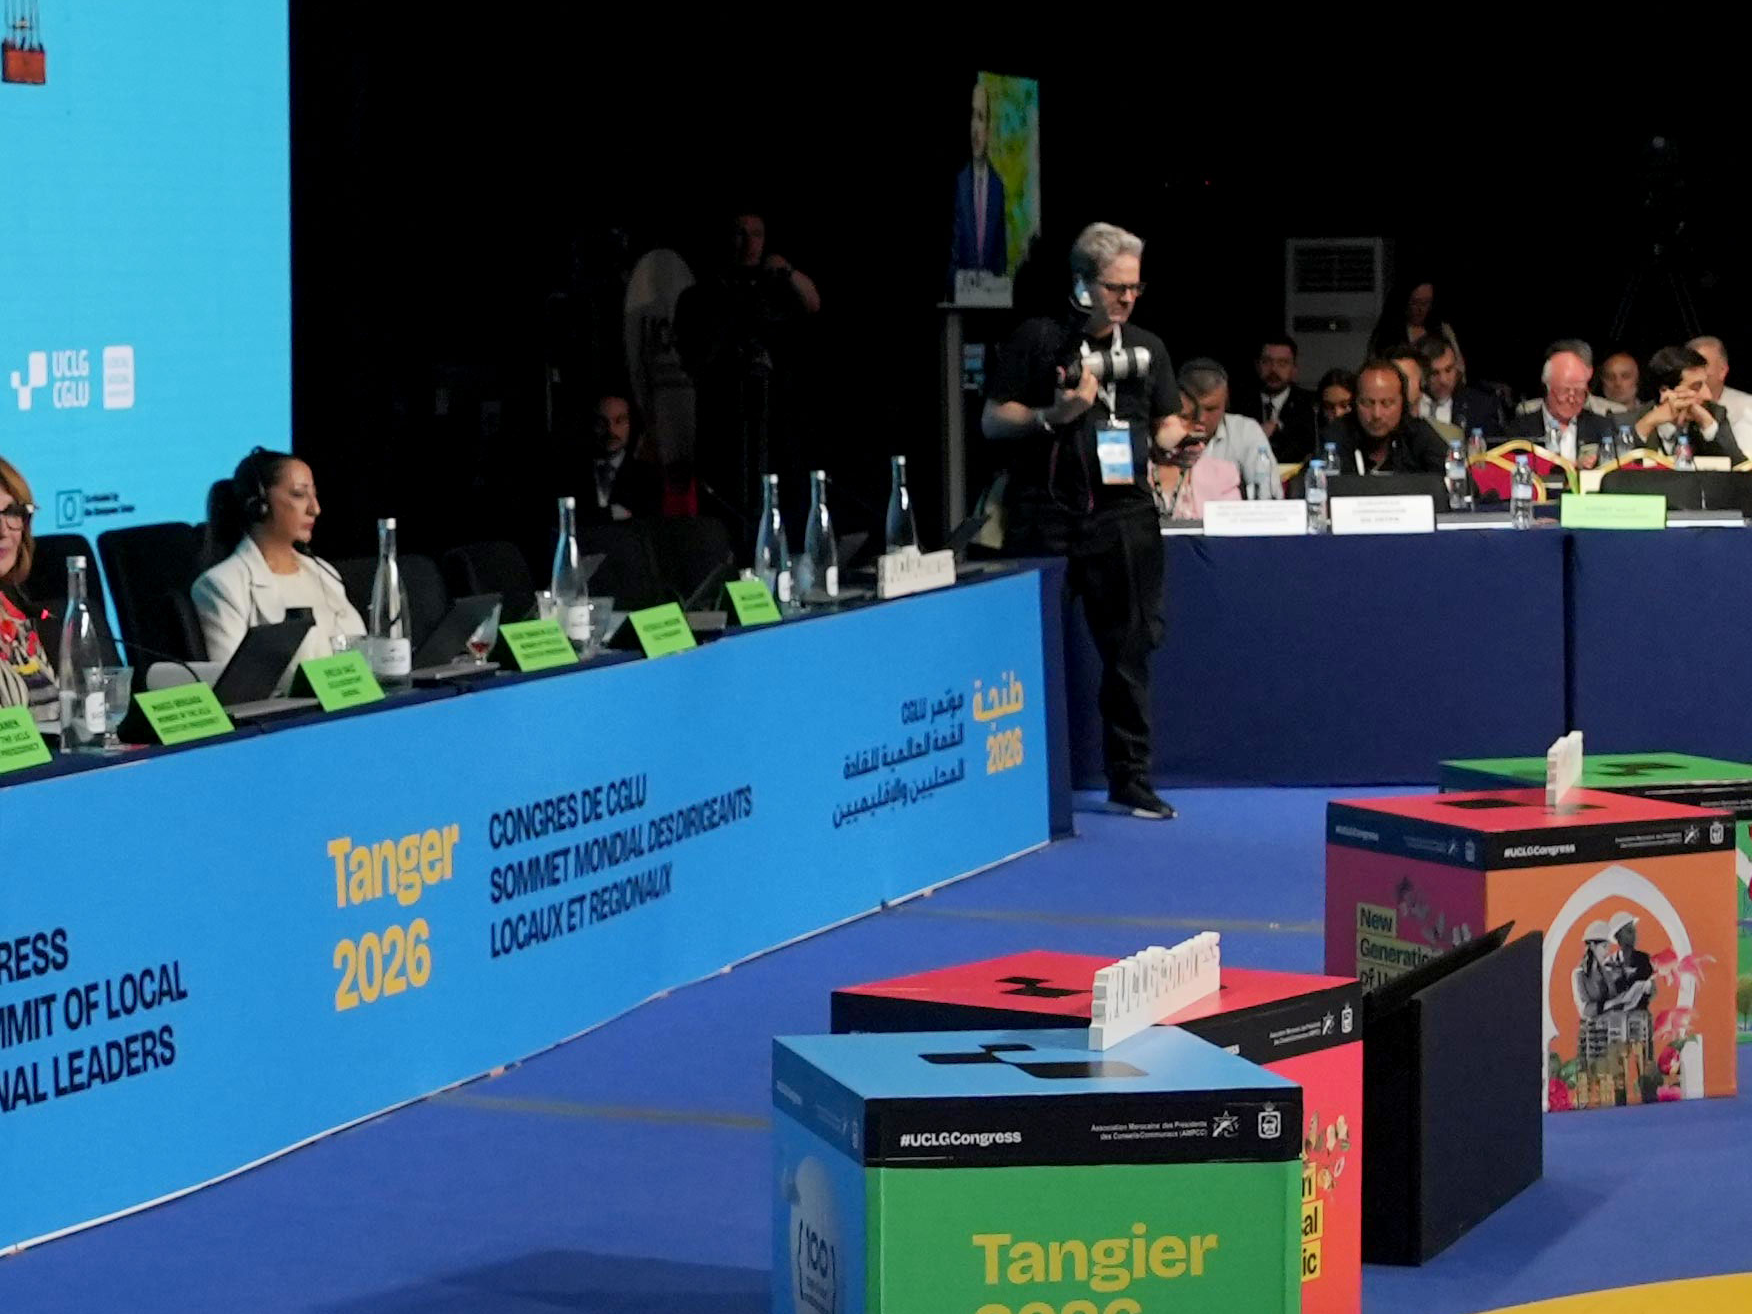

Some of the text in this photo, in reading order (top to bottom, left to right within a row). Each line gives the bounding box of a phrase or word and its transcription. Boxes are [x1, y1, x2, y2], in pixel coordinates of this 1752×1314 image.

[52, 349, 90, 377] UCLG
[53, 380, 90, 409] CGLU
[972, 669, 1025, 731] طنجة
[986, 727, 1024, 775] 2026
[489, 772, 648, 851] CONGRES DE CGLU
[490, 785, 753, 905] SOMMET MONDIAL DES DIRIGEANTS
[327, 822, 461, 908] Tanger
[490, 905, 564, 960] LOCAUX
[567, 894, 588, 933] ET
[1360, 906, 1393, 933] New
[62, 982, 100, 1032] OF
[105, 959, 188, 1020] LOCAL
[333, 917, 432, 1014] 2026
[52, 1024, 176, 1100] LEADERS
[900, 1131, 1022, 1148] #UCLGCongress
[972, 1222, 1219, 1293] Tangier
